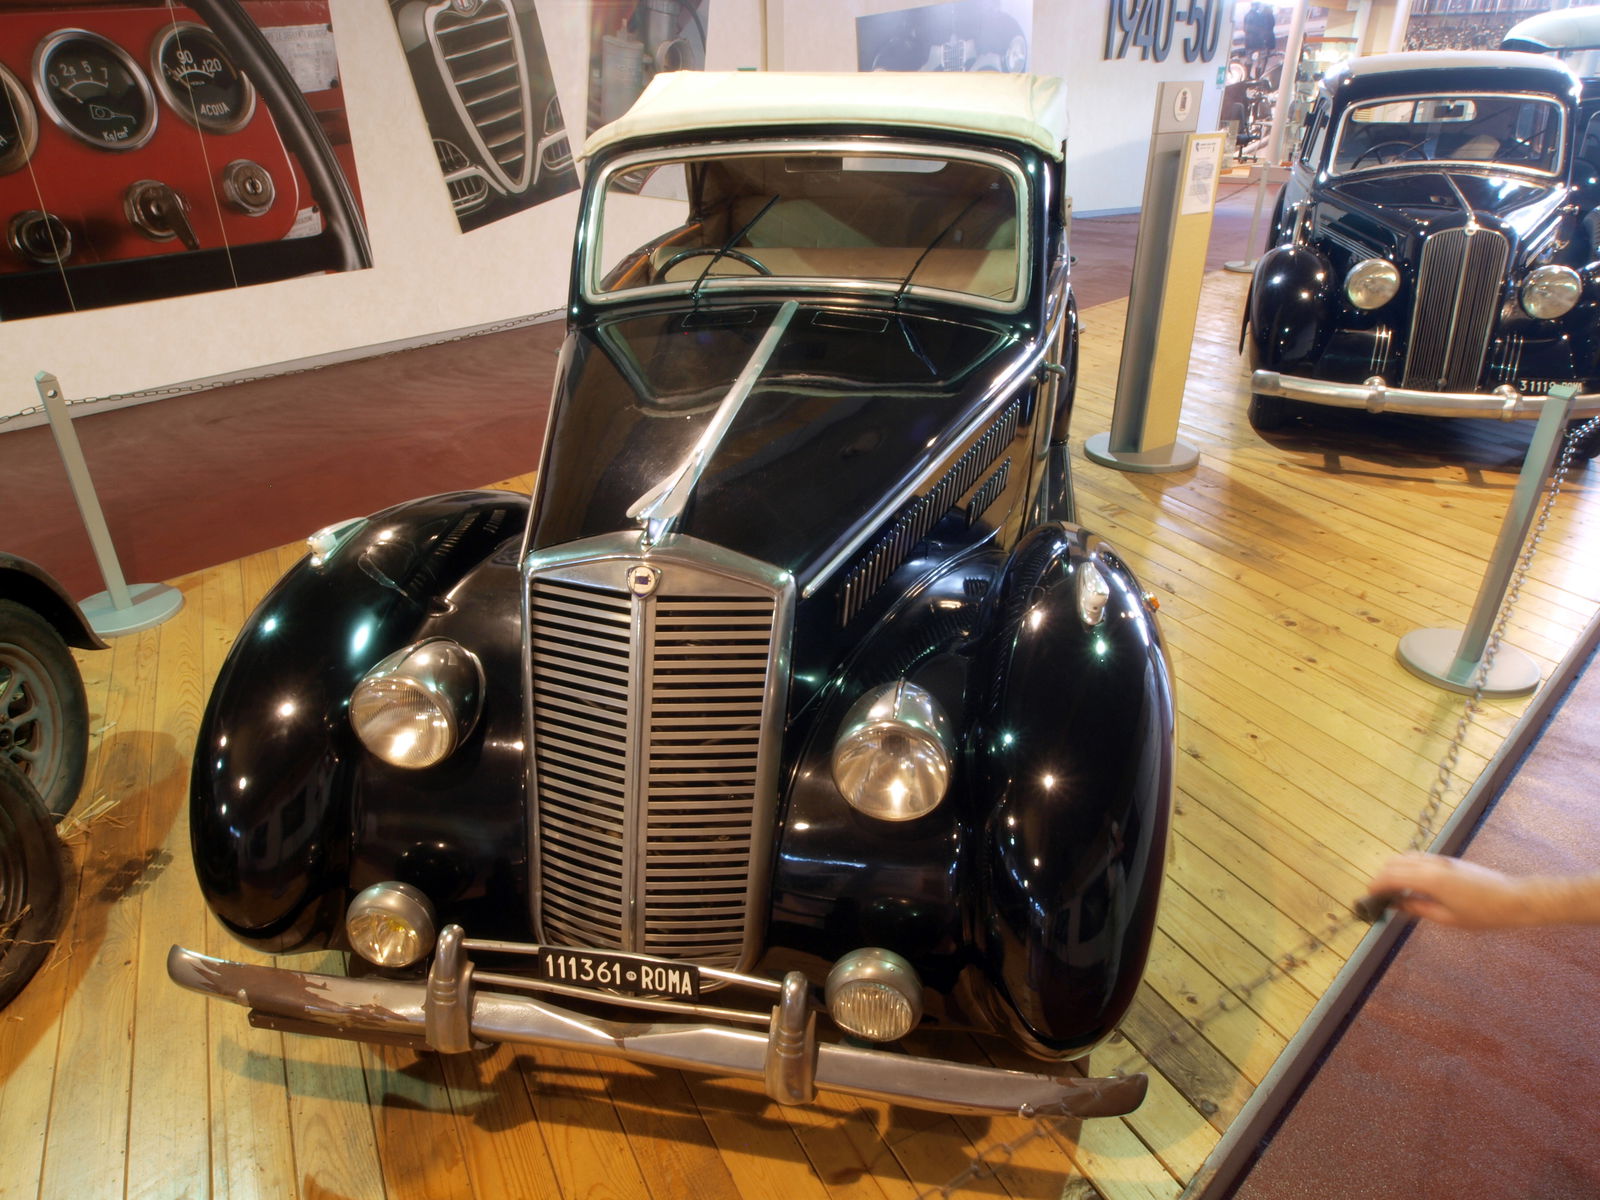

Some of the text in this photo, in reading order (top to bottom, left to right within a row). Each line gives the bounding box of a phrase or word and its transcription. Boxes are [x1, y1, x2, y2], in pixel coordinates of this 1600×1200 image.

[1103, 0, 1224, 63] 1940-50
[176, 50, 193, 65] 90
[200, 102, 230, 116] ACQUA
[545, 954, 692, 995] 111361 ROMA
